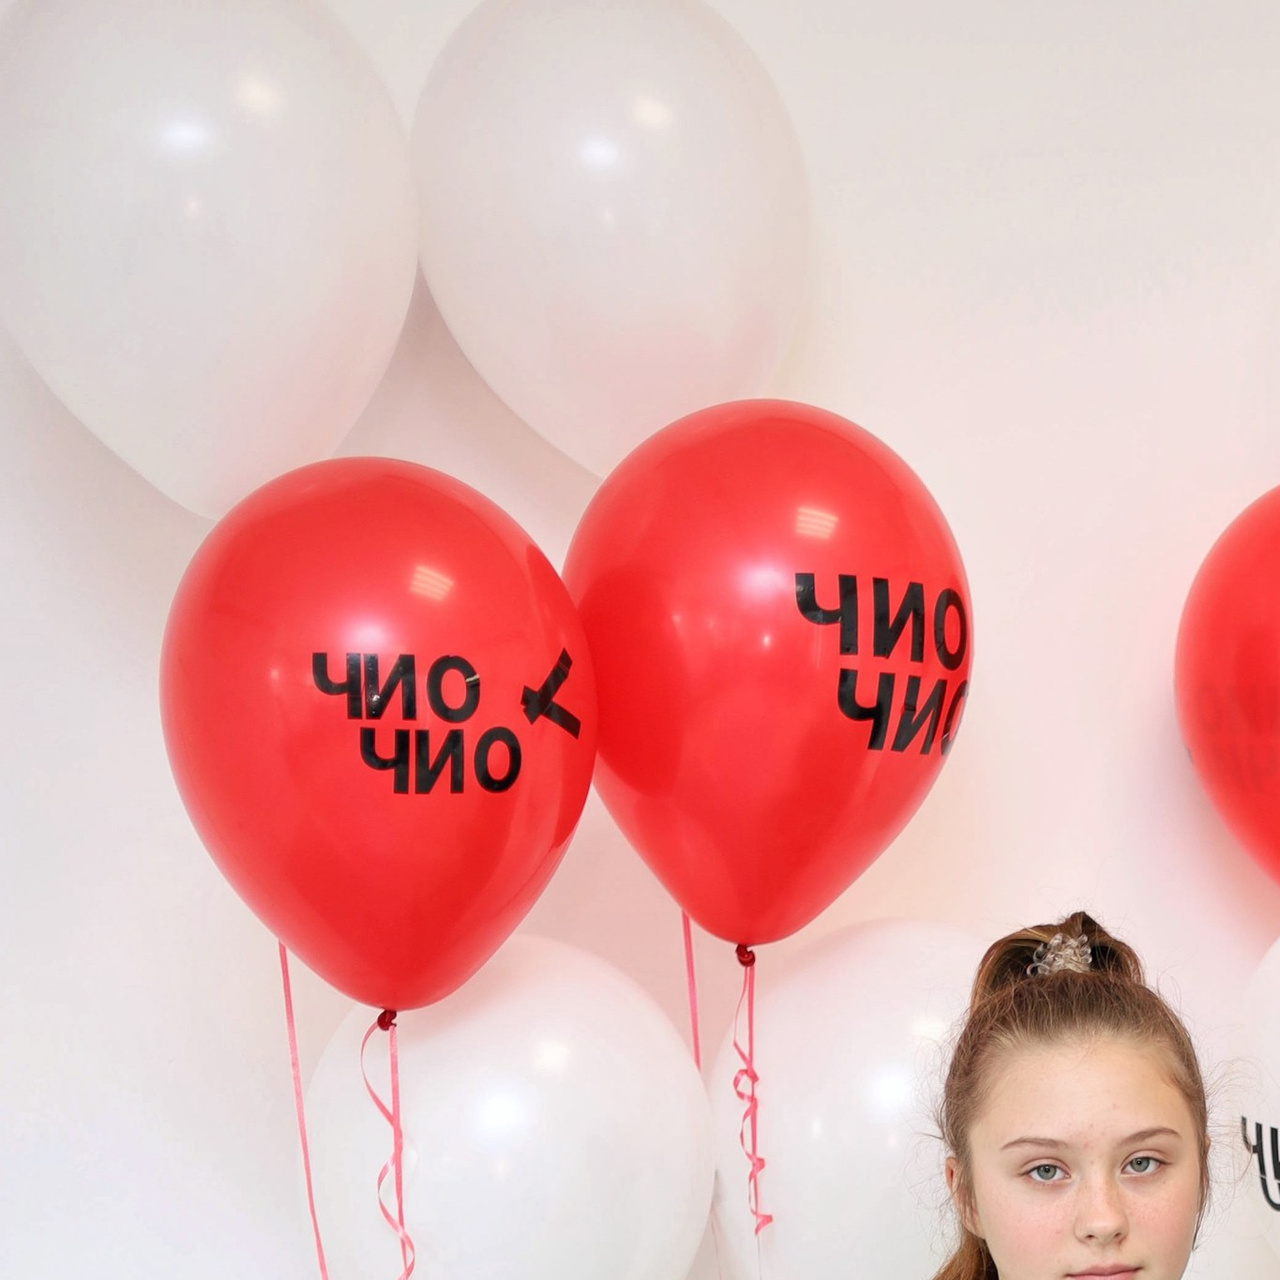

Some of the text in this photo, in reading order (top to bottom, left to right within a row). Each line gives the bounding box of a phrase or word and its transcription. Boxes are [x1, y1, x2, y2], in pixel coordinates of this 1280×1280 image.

[795, 573, 967, 670] ЧИО
[312, 652, 481, 723] ЧИО
[360, 727, 522, 794] ЧИО
